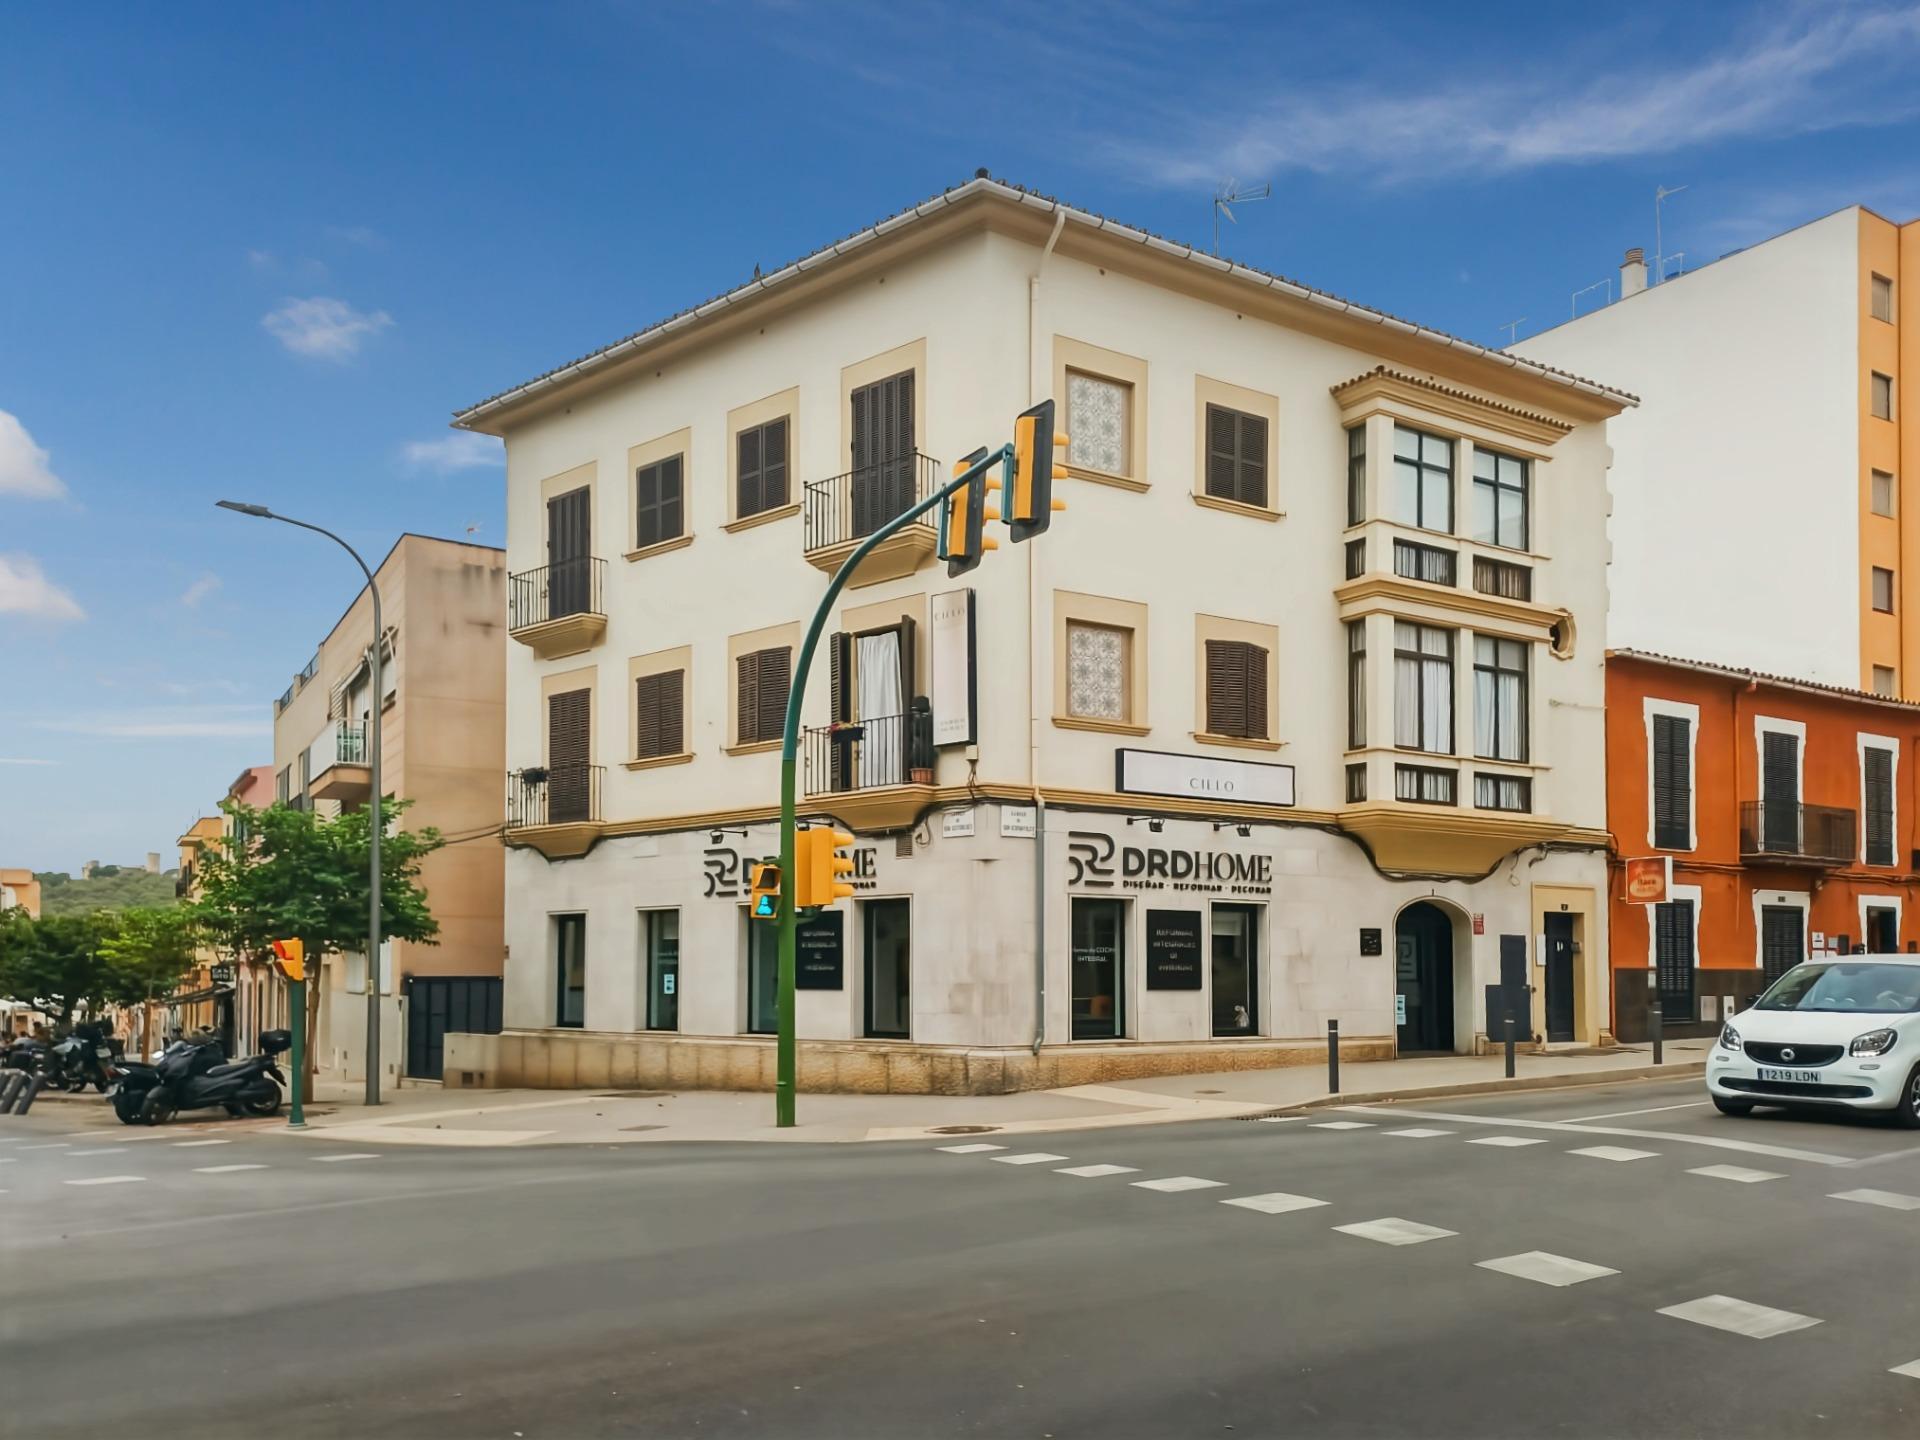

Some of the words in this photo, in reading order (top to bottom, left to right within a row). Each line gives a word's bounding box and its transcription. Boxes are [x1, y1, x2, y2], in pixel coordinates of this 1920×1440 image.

[1122, 846, 1273, 883] DRDHOME
[1765, 1070, 1792, 1081] 1219
[1795, 1071, 1818, 1082] LDN
